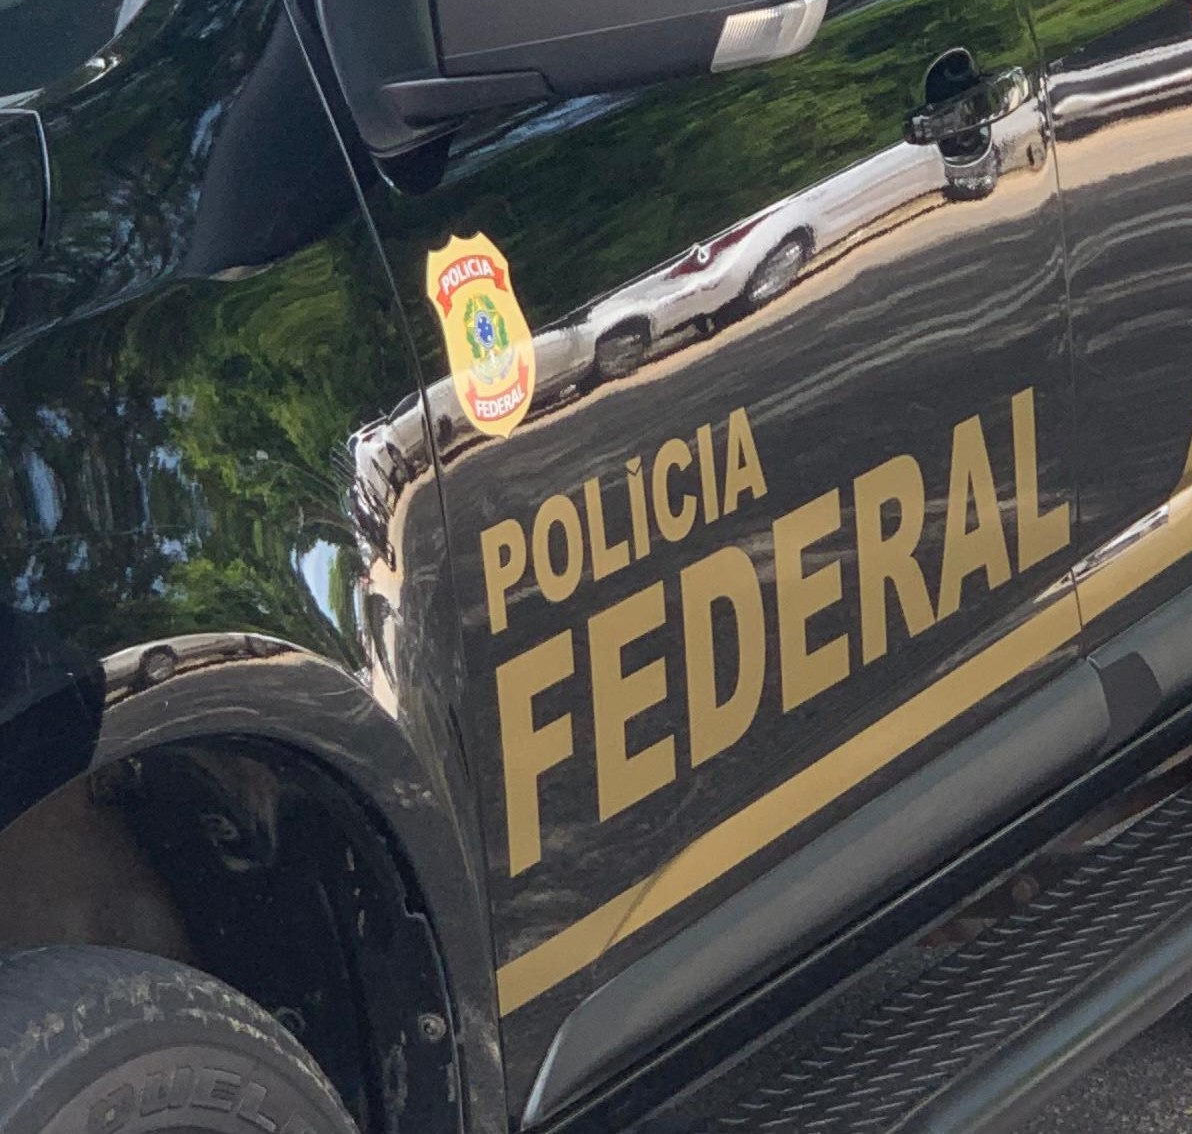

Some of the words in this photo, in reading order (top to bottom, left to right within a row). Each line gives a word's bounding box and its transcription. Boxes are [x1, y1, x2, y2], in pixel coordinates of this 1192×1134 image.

[474, 383, 526, 419] FEDERAL
[480, 406, 768, 635] POLÍCIA
[496, 386, 1072, 878] FEDERAL
